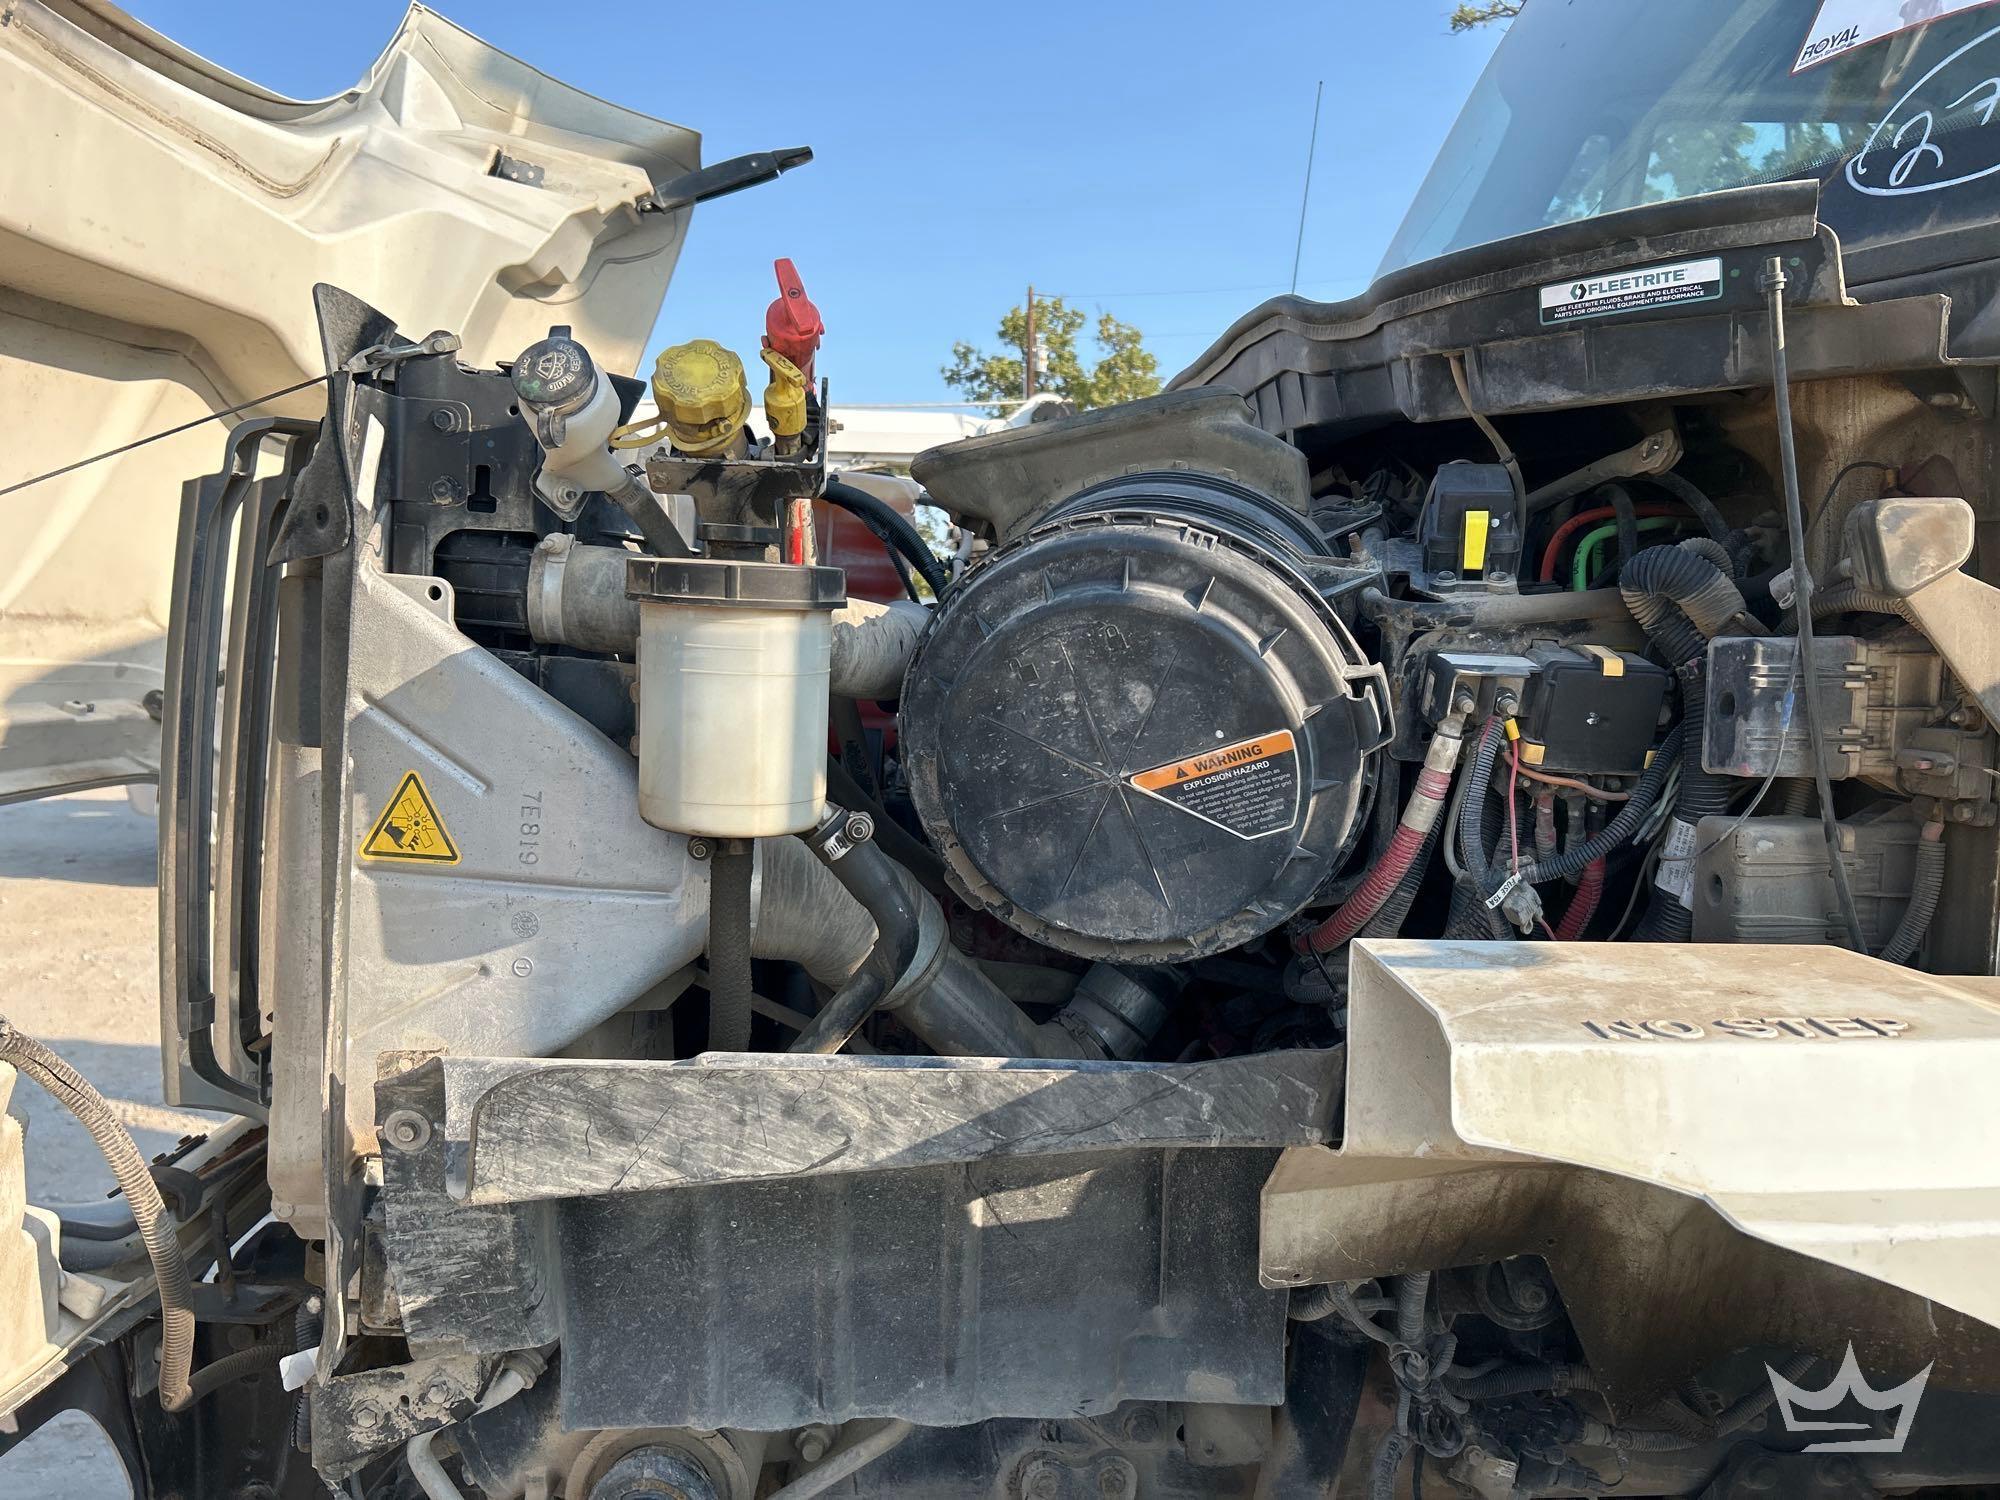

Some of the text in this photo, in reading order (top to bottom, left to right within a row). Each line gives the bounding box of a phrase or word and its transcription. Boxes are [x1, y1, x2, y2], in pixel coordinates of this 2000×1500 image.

[1801, 25, 1859, 61] ROYAL
[1587, 269, 1685, 295] FLEETRITE
[1567, 300, 1598, 310] FLEETRITE
[1623, 293, 1646, 301] BRAKE
[1662, 284, 1702, 295] ELECTRICAL
[1586, 304, 1615, 313] ORIGINAL
[1616, 297, 1653, 308] EQUIPMENT
[1654, 289, 1704, 302] PERFORMANCE
[547, 343, 581, 391] WASHER FLUID
[1193, 744, 1262, 772] WARNING
[1183, 760, 1270, 791] EXPLOSION HAZARD
[518, 790, 543, 865] 7E819
[1488, 878, 1517, 906] FUSE 15A
[1580, 1017, 1909, 1040] NO STEP
